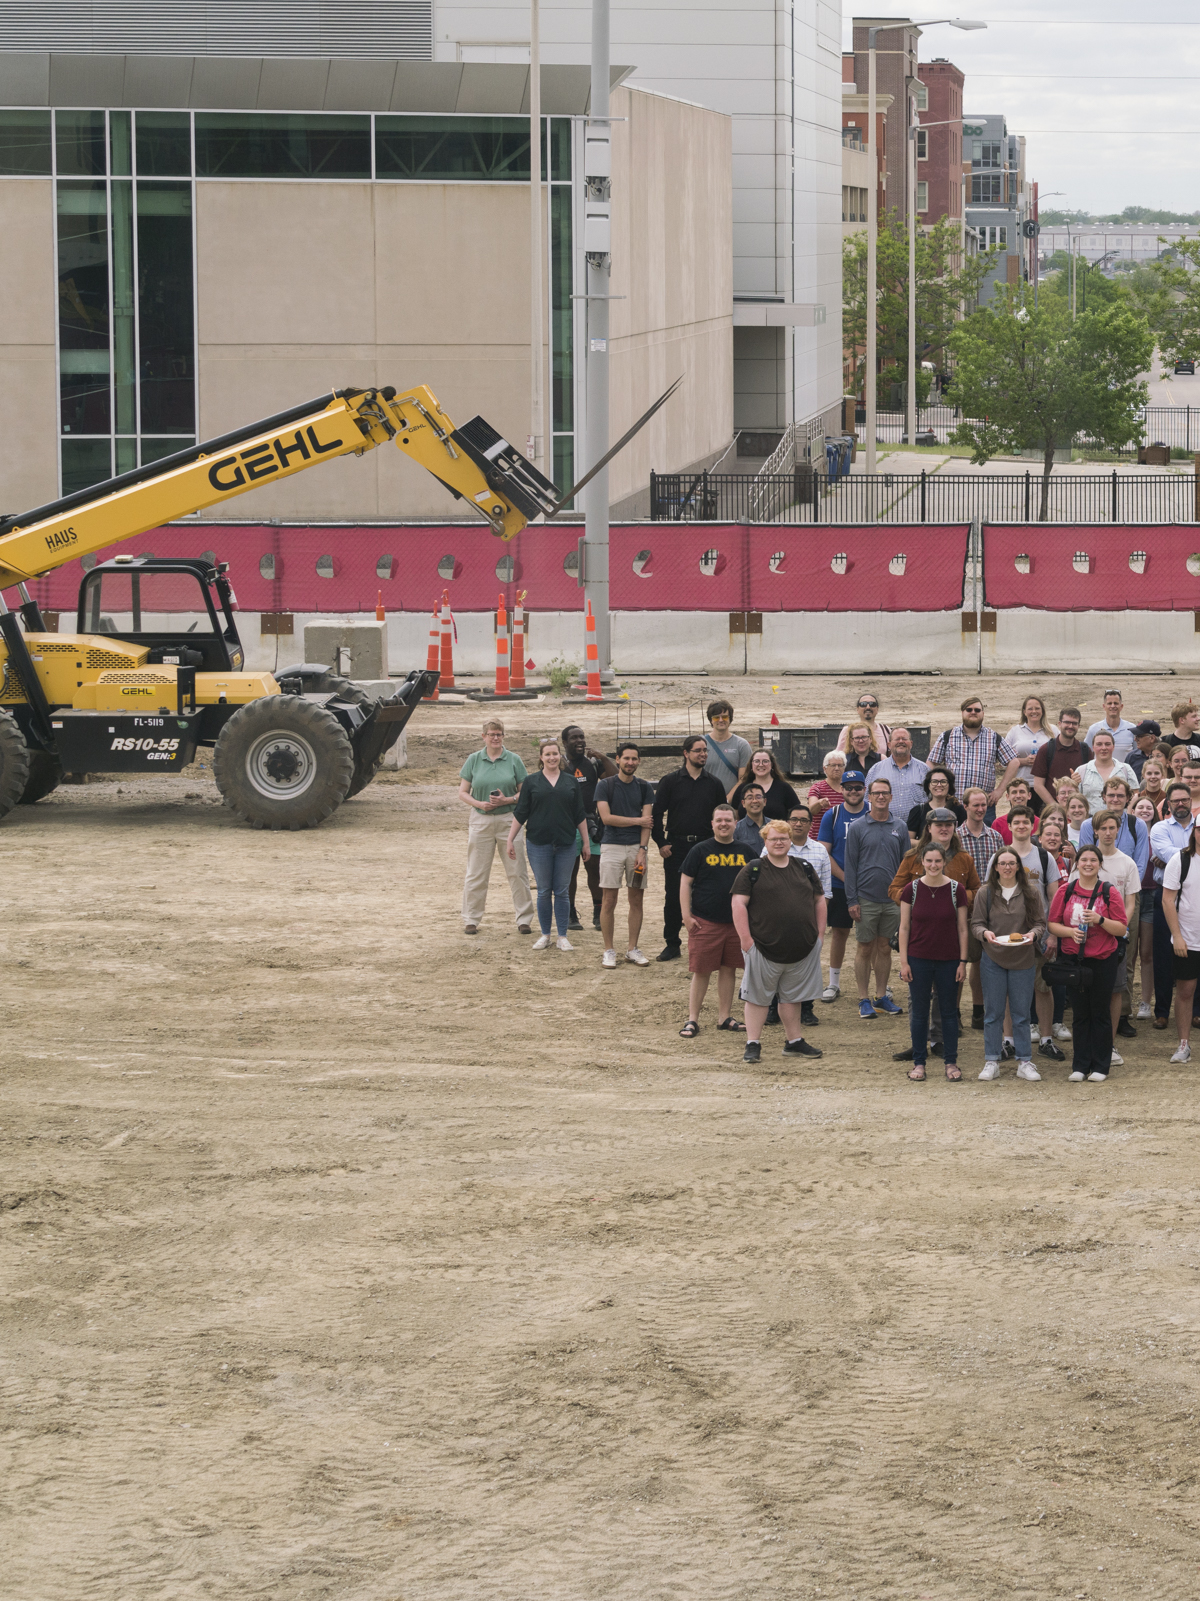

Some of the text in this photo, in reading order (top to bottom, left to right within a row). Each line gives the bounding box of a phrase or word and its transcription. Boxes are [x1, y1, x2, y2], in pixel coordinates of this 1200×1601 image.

[408, 423, 426, 433] GEHL
[208, 425, 343, 491] GEHL
[45, 527, 77, 549] HAUS
[50, 539, 78, 553] EQUIPMENT
[121, 687, 153, 695] GEHL
[134, 718, 164, 727] FL-5119
[111, 738, 180, 751] RS10-55
